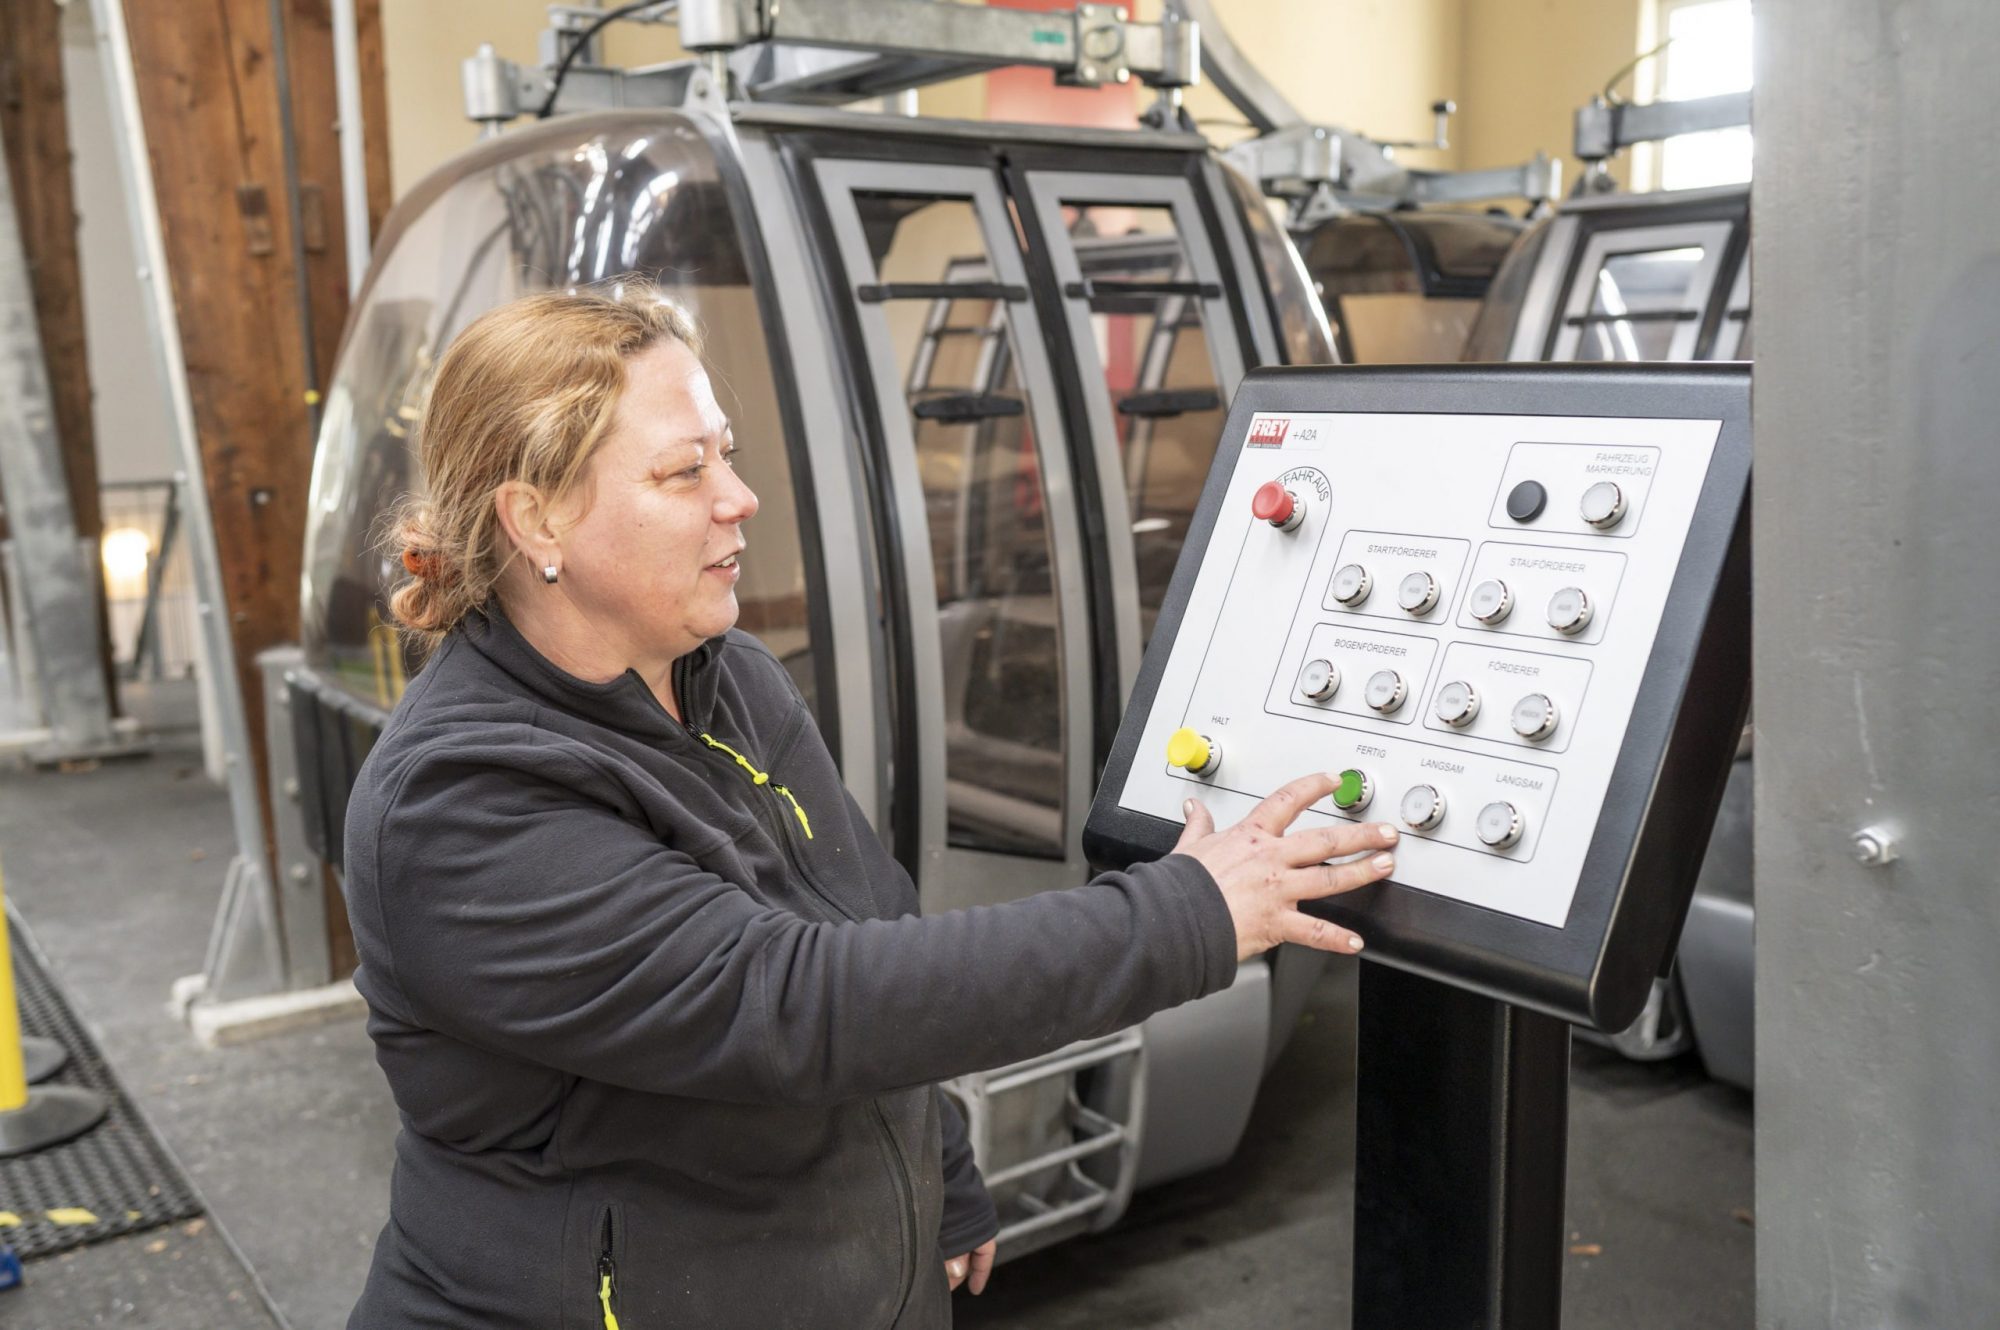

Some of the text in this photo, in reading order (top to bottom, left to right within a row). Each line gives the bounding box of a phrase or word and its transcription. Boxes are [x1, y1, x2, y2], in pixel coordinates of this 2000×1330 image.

[1251, 419, 1290, 437] FREY
[1595, 452, 1649, 464] FAHRZEUG
[1585, 464, 1652, 476] MARKIERUNG
[1311, 476, 1329, 502] AUS
[1211, 715, 1230, 726] HALT
[1356, 744, 1386, 758] FERTIG
[1420, 758, 1465, 774] LANGSAM
[1495, 773, 1544, 790] LANGSAM
